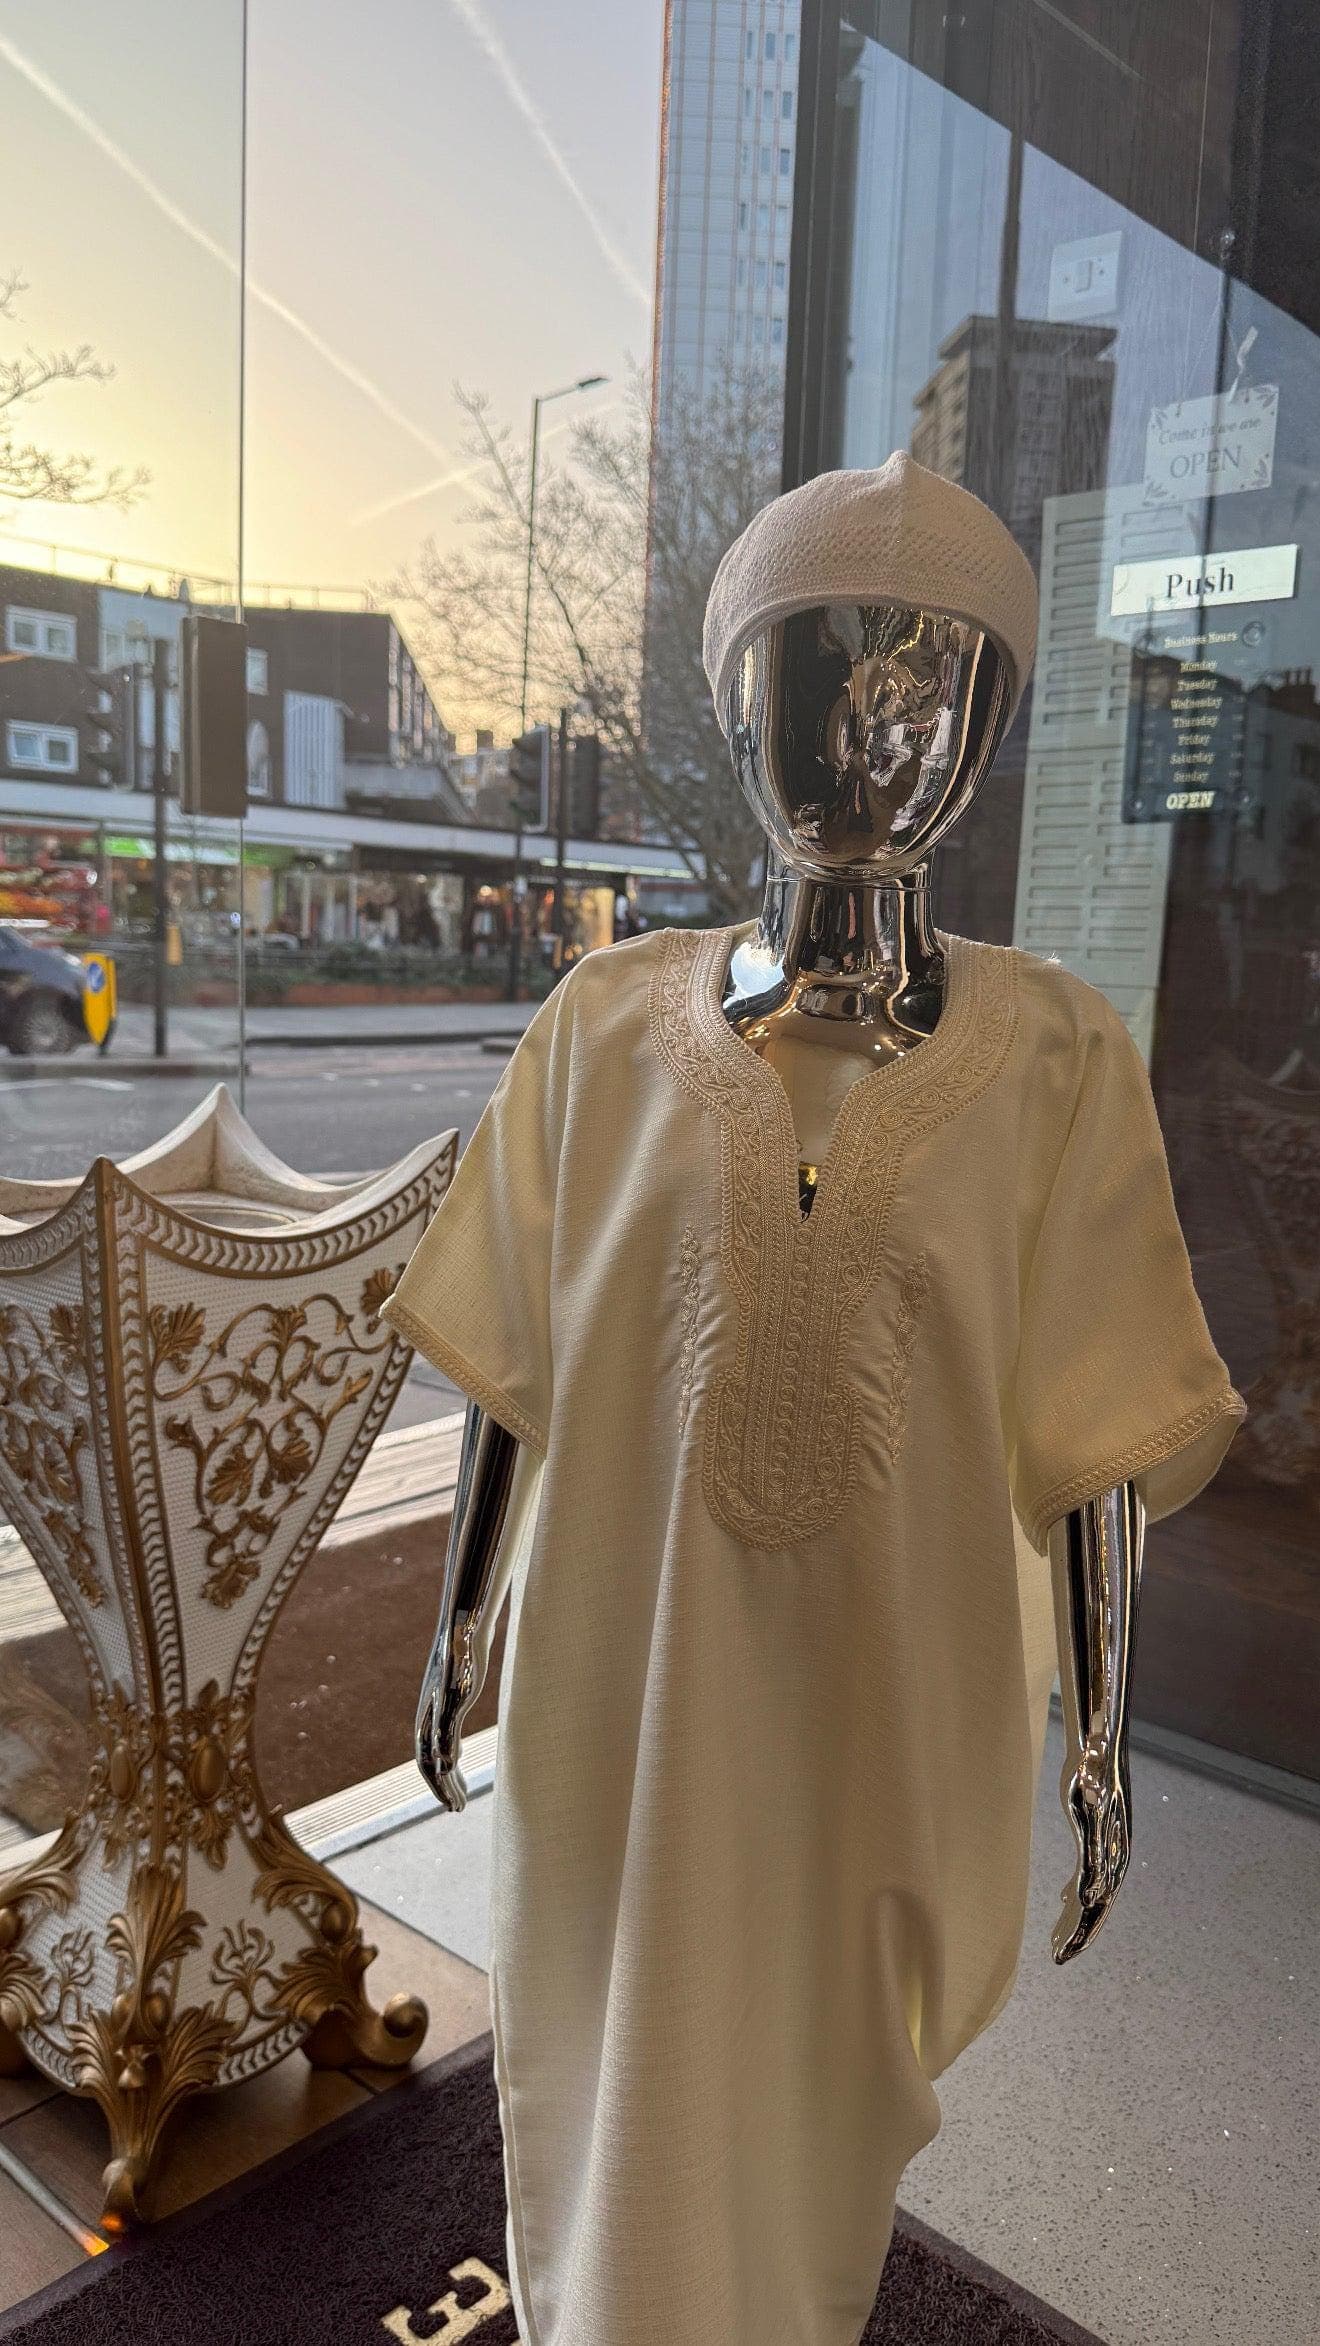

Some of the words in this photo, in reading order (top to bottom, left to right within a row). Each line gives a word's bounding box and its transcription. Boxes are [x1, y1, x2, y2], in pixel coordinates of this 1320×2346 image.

[1158, 426, 1198, 445] Come
[1239, 416, 1262, 431] are
[1169, 445, 1242, 479] OPEN
[1165, 567, 1234, 599] Push
[1165, 790, 1216, 810] OPEN
